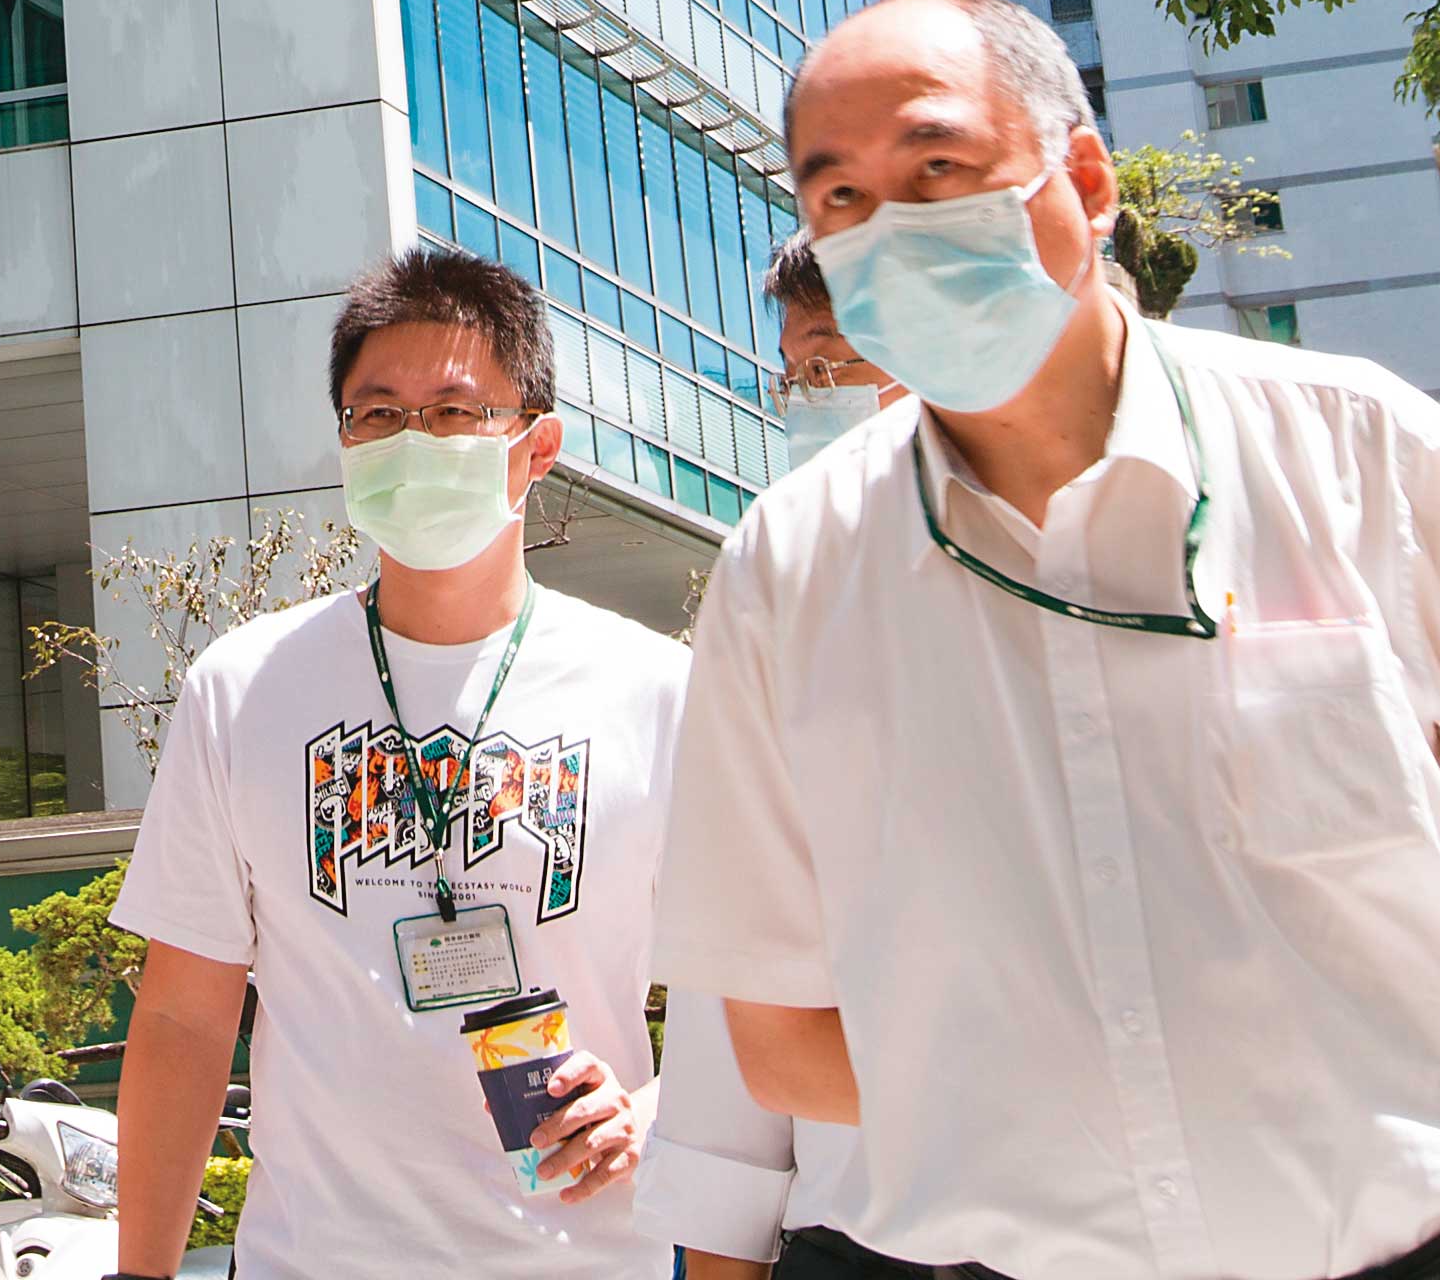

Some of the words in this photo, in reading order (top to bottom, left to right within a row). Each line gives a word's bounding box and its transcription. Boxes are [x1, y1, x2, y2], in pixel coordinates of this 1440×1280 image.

[355, 878, 405, 887] WELCOME
[410, 879, 423, 888] TO
[451, 882, 496, 891] ECSTASY
